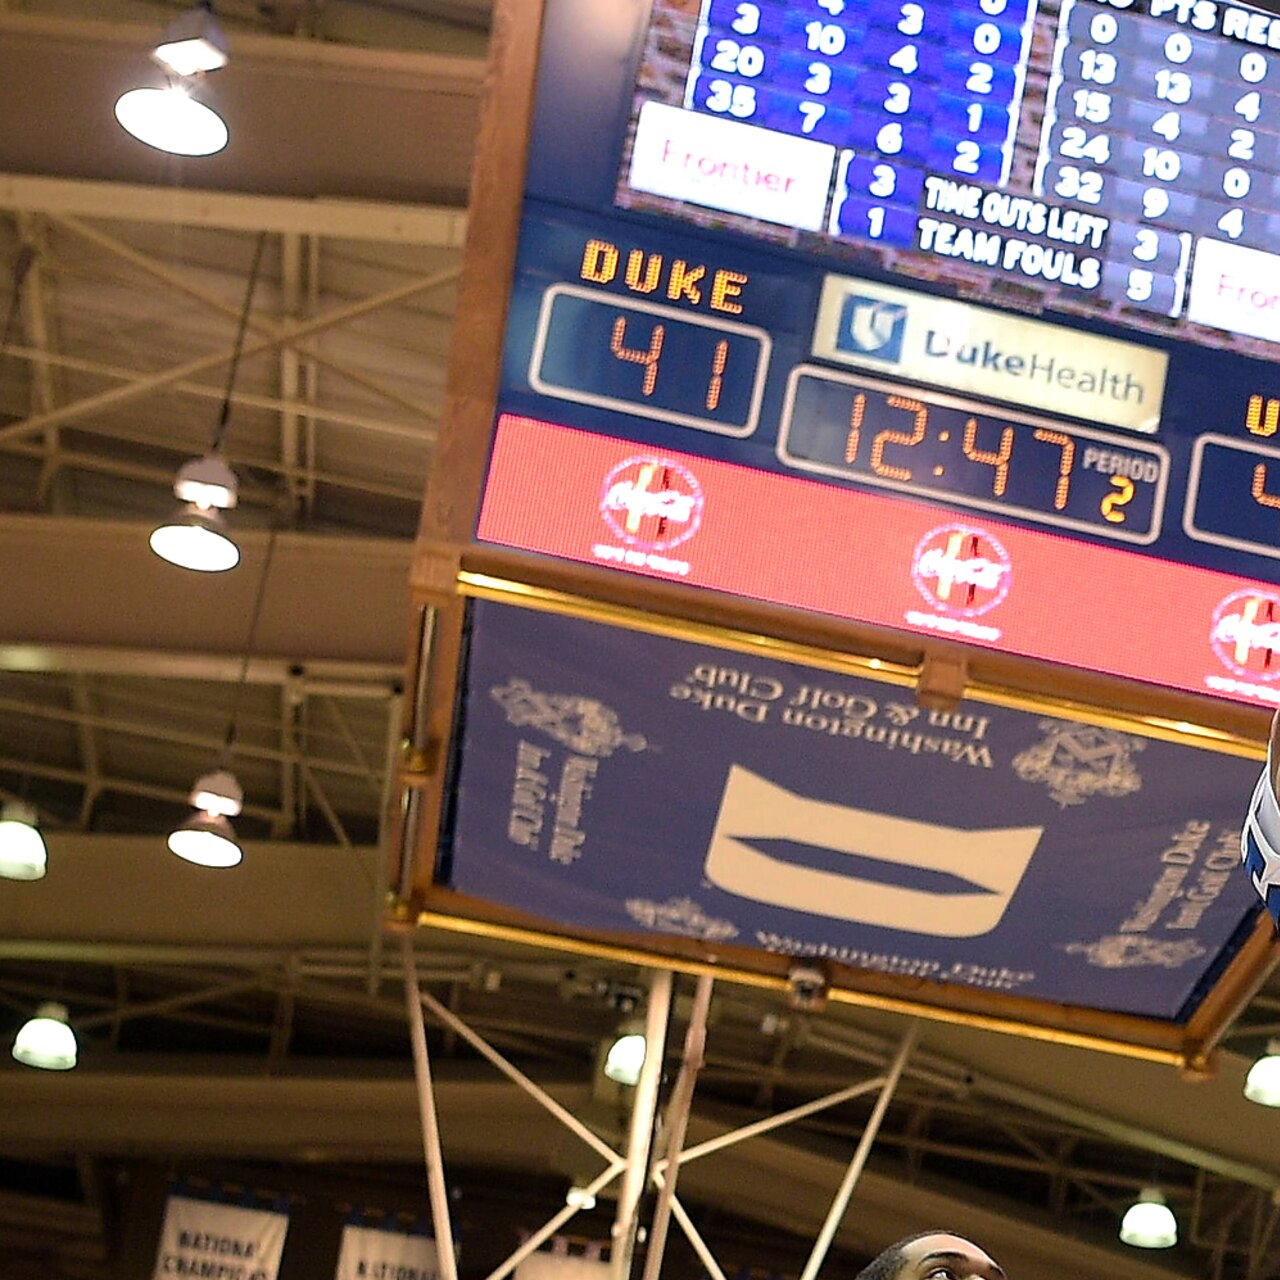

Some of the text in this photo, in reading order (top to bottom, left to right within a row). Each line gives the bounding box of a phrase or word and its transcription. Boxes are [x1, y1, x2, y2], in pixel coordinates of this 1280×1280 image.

[732, 3, 993, 94] 3 10 4 2
[898, 3, 1001, 54] 3 0
[1091, 14, 1118, 43] 0
[1165, 33, 1192, 63] 0
[1240, 53, 1267, 83] 0
[711, 40, 982, 132] 20 3 3 1
[1080, 50, 1117, 84] 13
[1155, 69, 1192, 103] 13
[1234, 92, 1260, 122] 4
[706, 79, 980, 174] 35 7 6 2
[1073, 90, 1111, 122] 15
[1152, 112, 1180, 140] 4
[1228, 129, 1255, 160] 2
[662, 138, 796, 194] Frontier
[1060, 127, 1110, 163] 24
[1143, 148, 1181, 180] 10
[1223, 168, 1250, 198] 0
[869, 165, 1159, 260] 3 TIME OUTS LEFT 3
[1055, 166, 1103, 204] 32
[1143, 187, 1168, 218] 9
[1218, 208, 1243, 238] 4
[581, 240, 748, 314] DUKE
[868, 207, 1152, 300] 1 TEAM FOULS 5
[611, 316, 728, 410] 41
[845, 392, 1075, 510] 12:47
[1083, 447, 1158, 484] PERIOD
[1101, 475, 1134, 523] 2
[669, 681, 993, 768] Washington Duke
